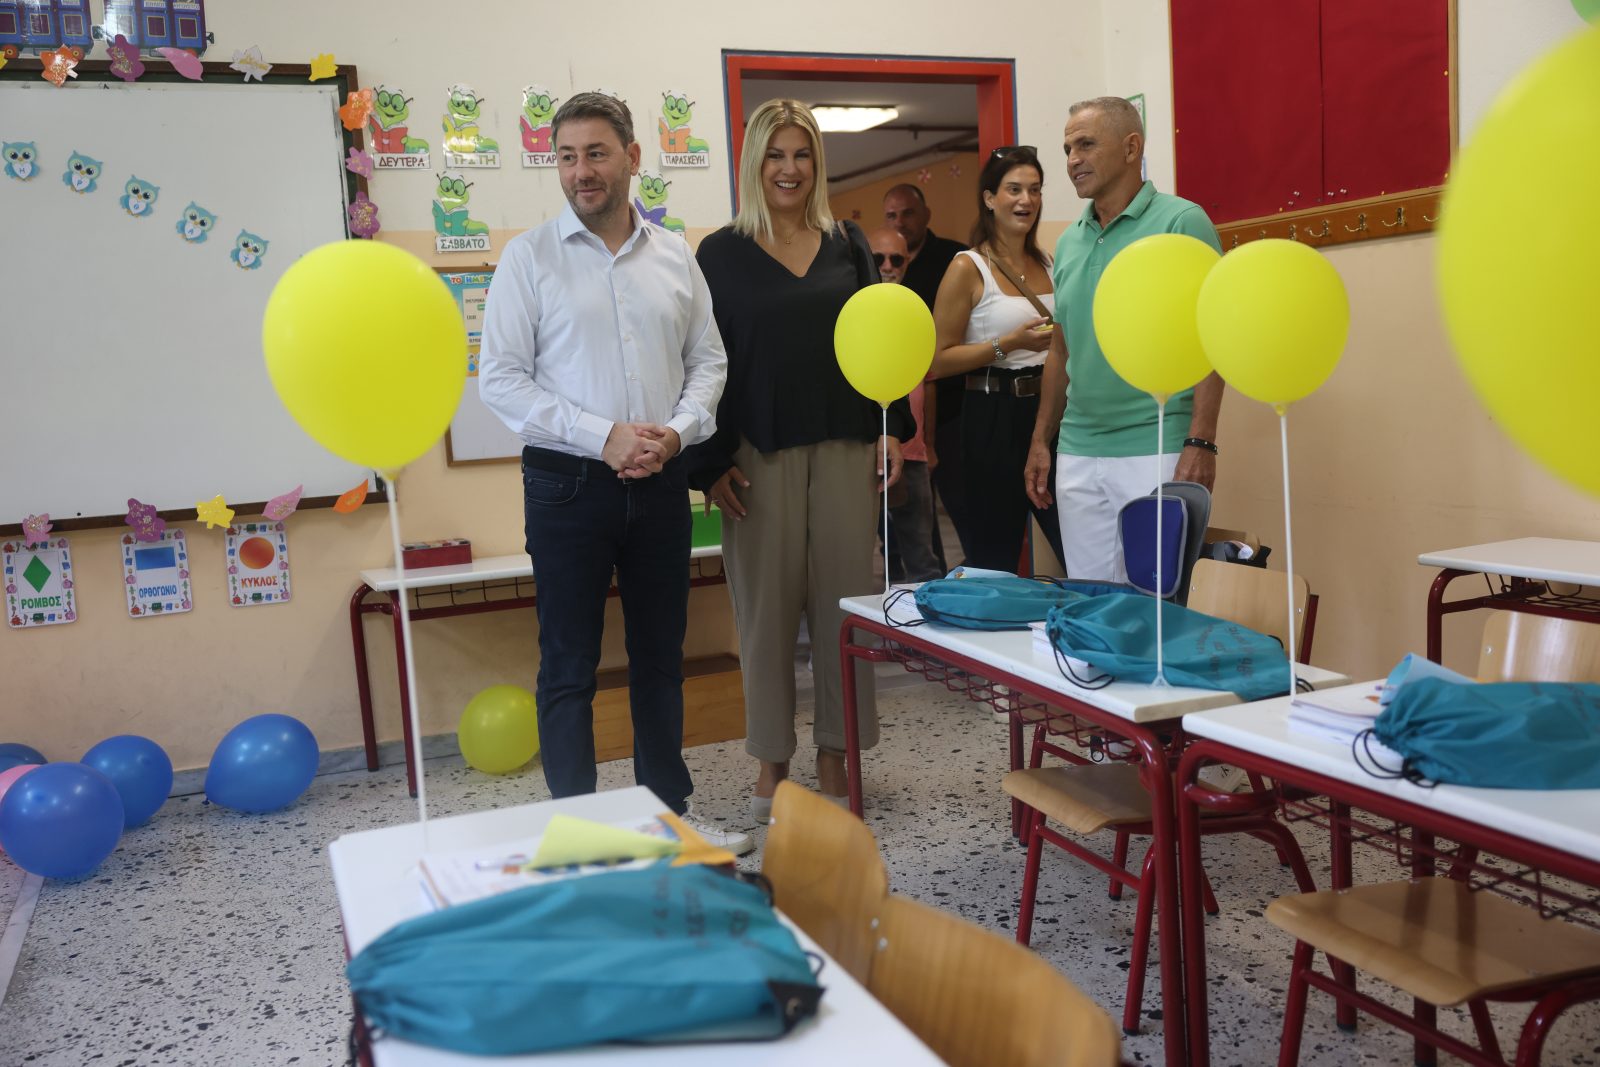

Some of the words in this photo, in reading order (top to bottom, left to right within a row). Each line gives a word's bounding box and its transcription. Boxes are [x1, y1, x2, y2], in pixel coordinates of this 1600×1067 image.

[379, 156, 425, 167] ΔΕΥΤΕΡΑ
[527, 154, 557, 165] ΤΕΤΑΡ
[665, 155, 706, 165] ΠΑΡΑΣΚΕΥΗ
[440, 238, 485, 249] ΣΑΒΒΑΤΟ
[241, 575, 278, 589] ΚΥΚΛΟΣ
[138, 584, 177, 598] ΟΡΘΟΓΩΝΙΟ
[20, 595, 61, 610] ΡΟΜΒΟΣ
